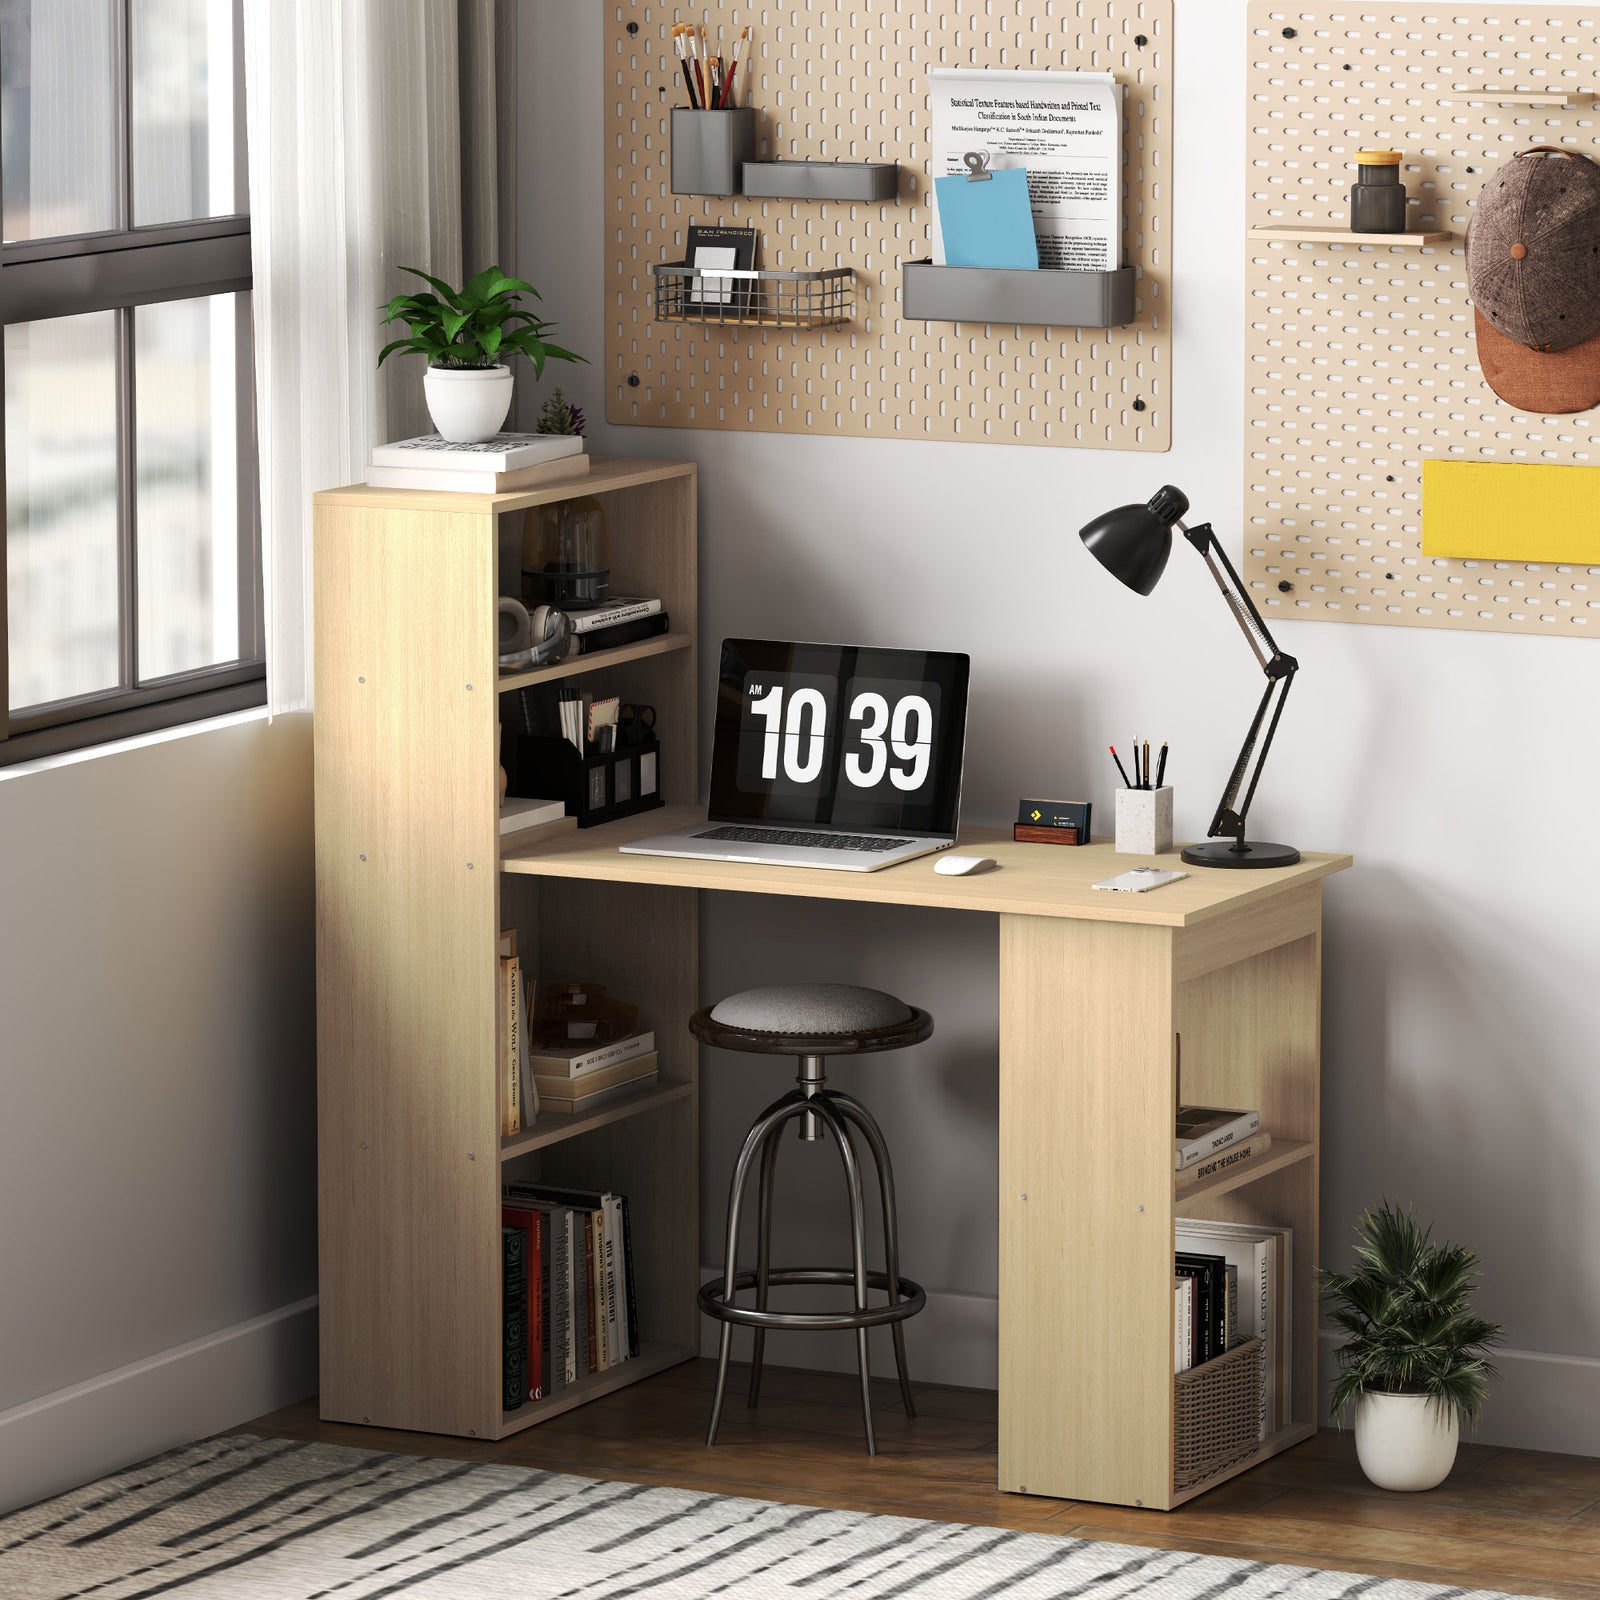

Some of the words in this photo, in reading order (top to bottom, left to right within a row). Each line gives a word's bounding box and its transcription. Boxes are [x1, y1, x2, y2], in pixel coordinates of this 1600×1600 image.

[950, 97, 974, 107] Statistical
[974, 98, 994, 108] Texture
[994, 99, 1015, 109] Features
[1015, 100, 1029, 109] based
[1030, 100, 1060, 110] Handwritten
[1061, 101, 1071, 110] and
[1071, 101, 1088, 111] Printed
[1089, 102, 1102, 111] Text
[978, 111, 1010, 120] Classification
[1011, 112, 1017, 120] in
[1017, 112, 1032, 121] South
[1032, 113, 1048, 121] Indian
[1049, 113, 1077, 122] Documents
[749, 684, 762, 696] AM
[751, 686, 827, 783] 10
[845, 692, 933, 791] 39
[1197, 1161, 1218, 1178] BRINGING
[1218, 1158, 1226, 1170] THE
[1226, 1151, 1239, 1167] HOUSE
[555, 1234, 567, 1383] INNENARCHITEKTUR
